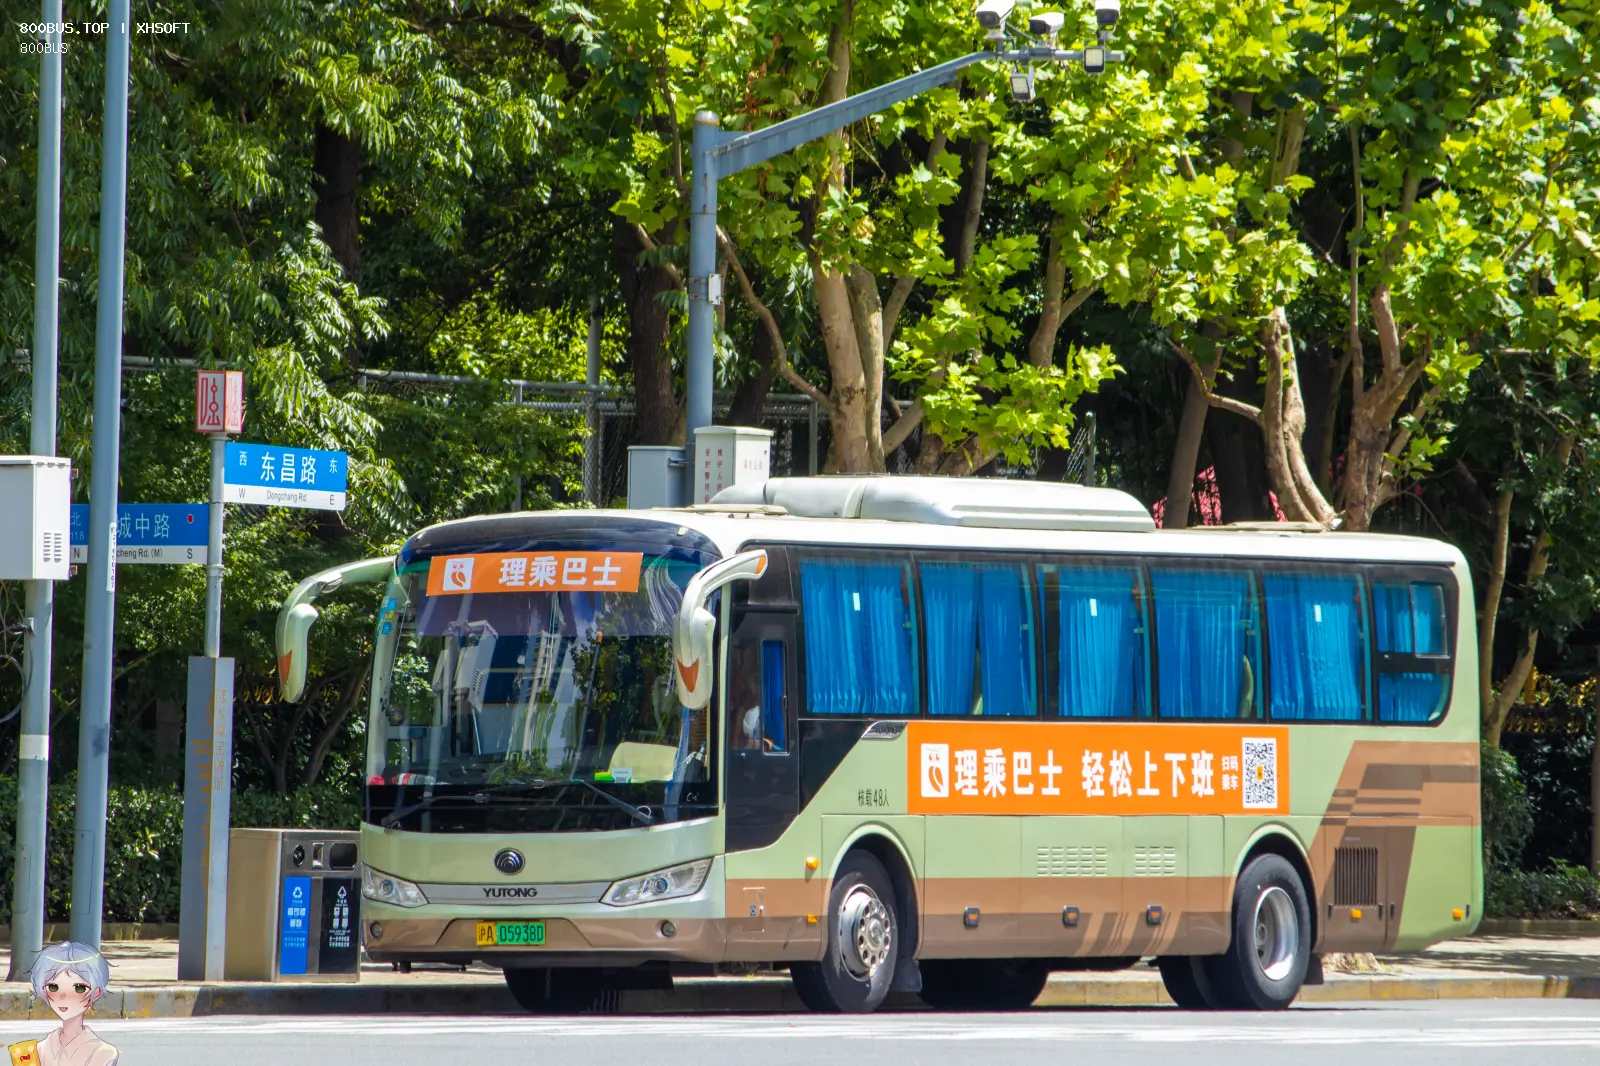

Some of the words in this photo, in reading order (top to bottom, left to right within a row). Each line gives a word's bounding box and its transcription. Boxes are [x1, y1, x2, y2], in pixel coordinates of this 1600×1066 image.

[238, 450, 248, 467] 西
[260, 451, 317, 485] 东昌路
[329, 457, 338, 474] 东
[238, 487, 246, 499] W
[266, 490, 298, 503] Dongchang
[329, 494, 335, 505] E
[70, 514, 81, 526] 北
[116, 512, 171, 539] 城中路
[73, 548, 80, 559] N
[187, 548, 193, 559] S
[498, 555, 622, 588] 理乘巴士
[954, 748, 1063, 798] 理乘巴士
[1081, 749, 1216, 798] 轻松上下班
[858, 788, 890, 807] 核载48人
[483, 887, 538, 898] YUTONG
